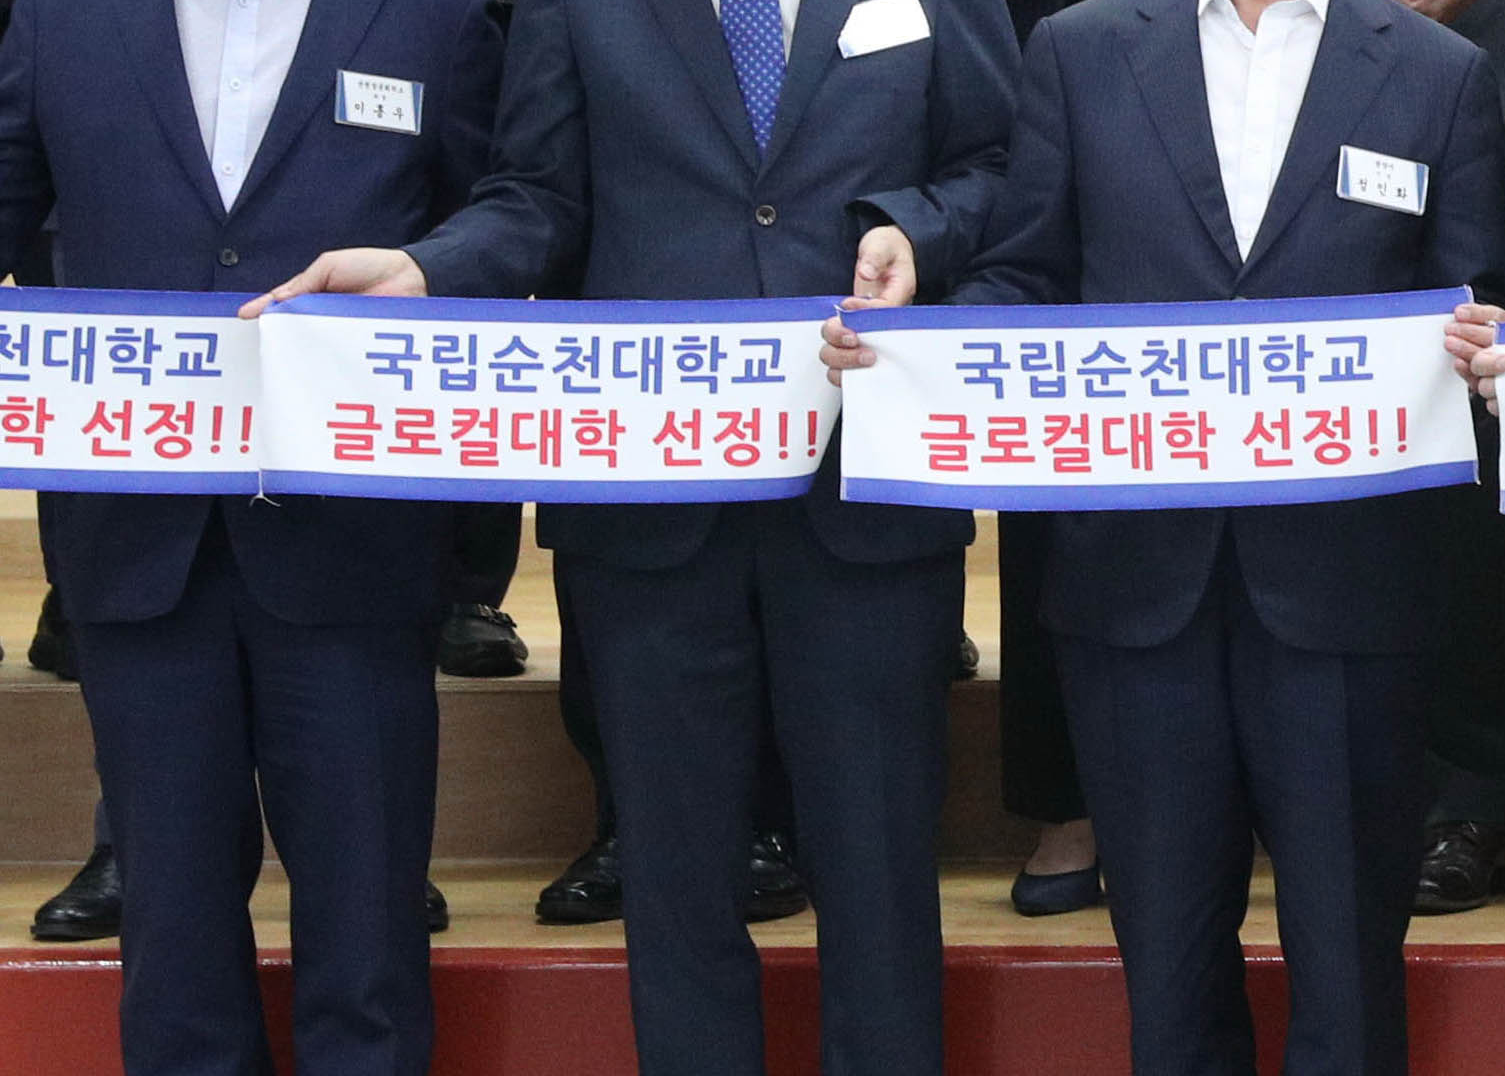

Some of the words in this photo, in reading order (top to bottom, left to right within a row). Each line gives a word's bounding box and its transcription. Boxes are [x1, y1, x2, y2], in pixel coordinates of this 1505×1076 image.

[0, 324, 222, 386] 천대학교
[364, 331, 786, 395] 국립순천대학교
[955, 333, 1374, 399] 국립순천대학교
[81, 400, 253, 459] 선정!!
[326, 402, 626, 468] 글로컬대학
[653, 407, 819, 470] 선정!!
[920, 411, 1216, 474] 글로컬대학
[1243, 405, 1409, 469] 선정!!
